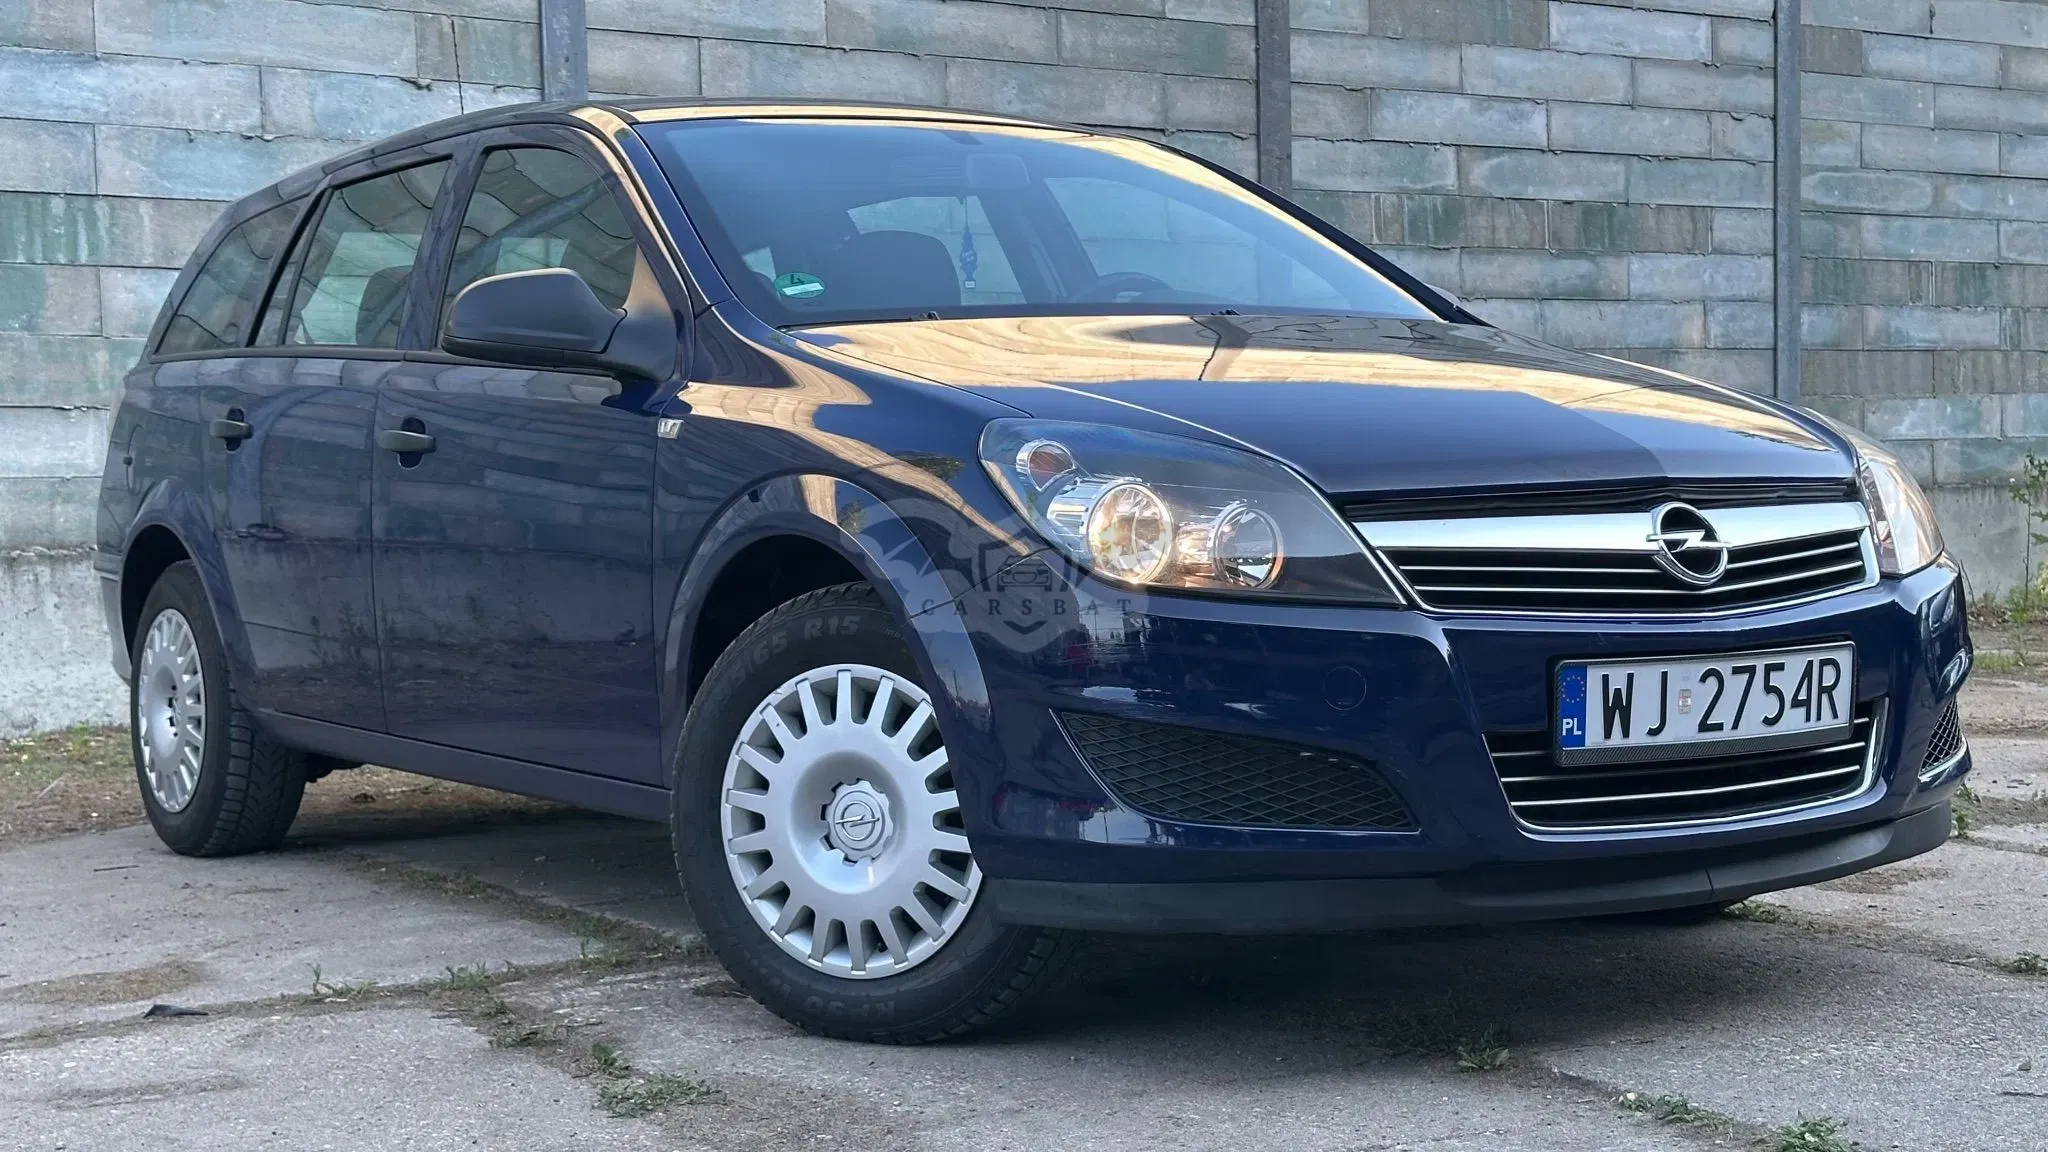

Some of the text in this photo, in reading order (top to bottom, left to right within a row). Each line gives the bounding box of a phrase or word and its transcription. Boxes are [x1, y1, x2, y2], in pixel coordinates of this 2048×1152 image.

[803, 615, 861, 640] R15
[1601, 657, 1841, 739] WJ 2754R
[1561, 718, 1582, 736] PL
